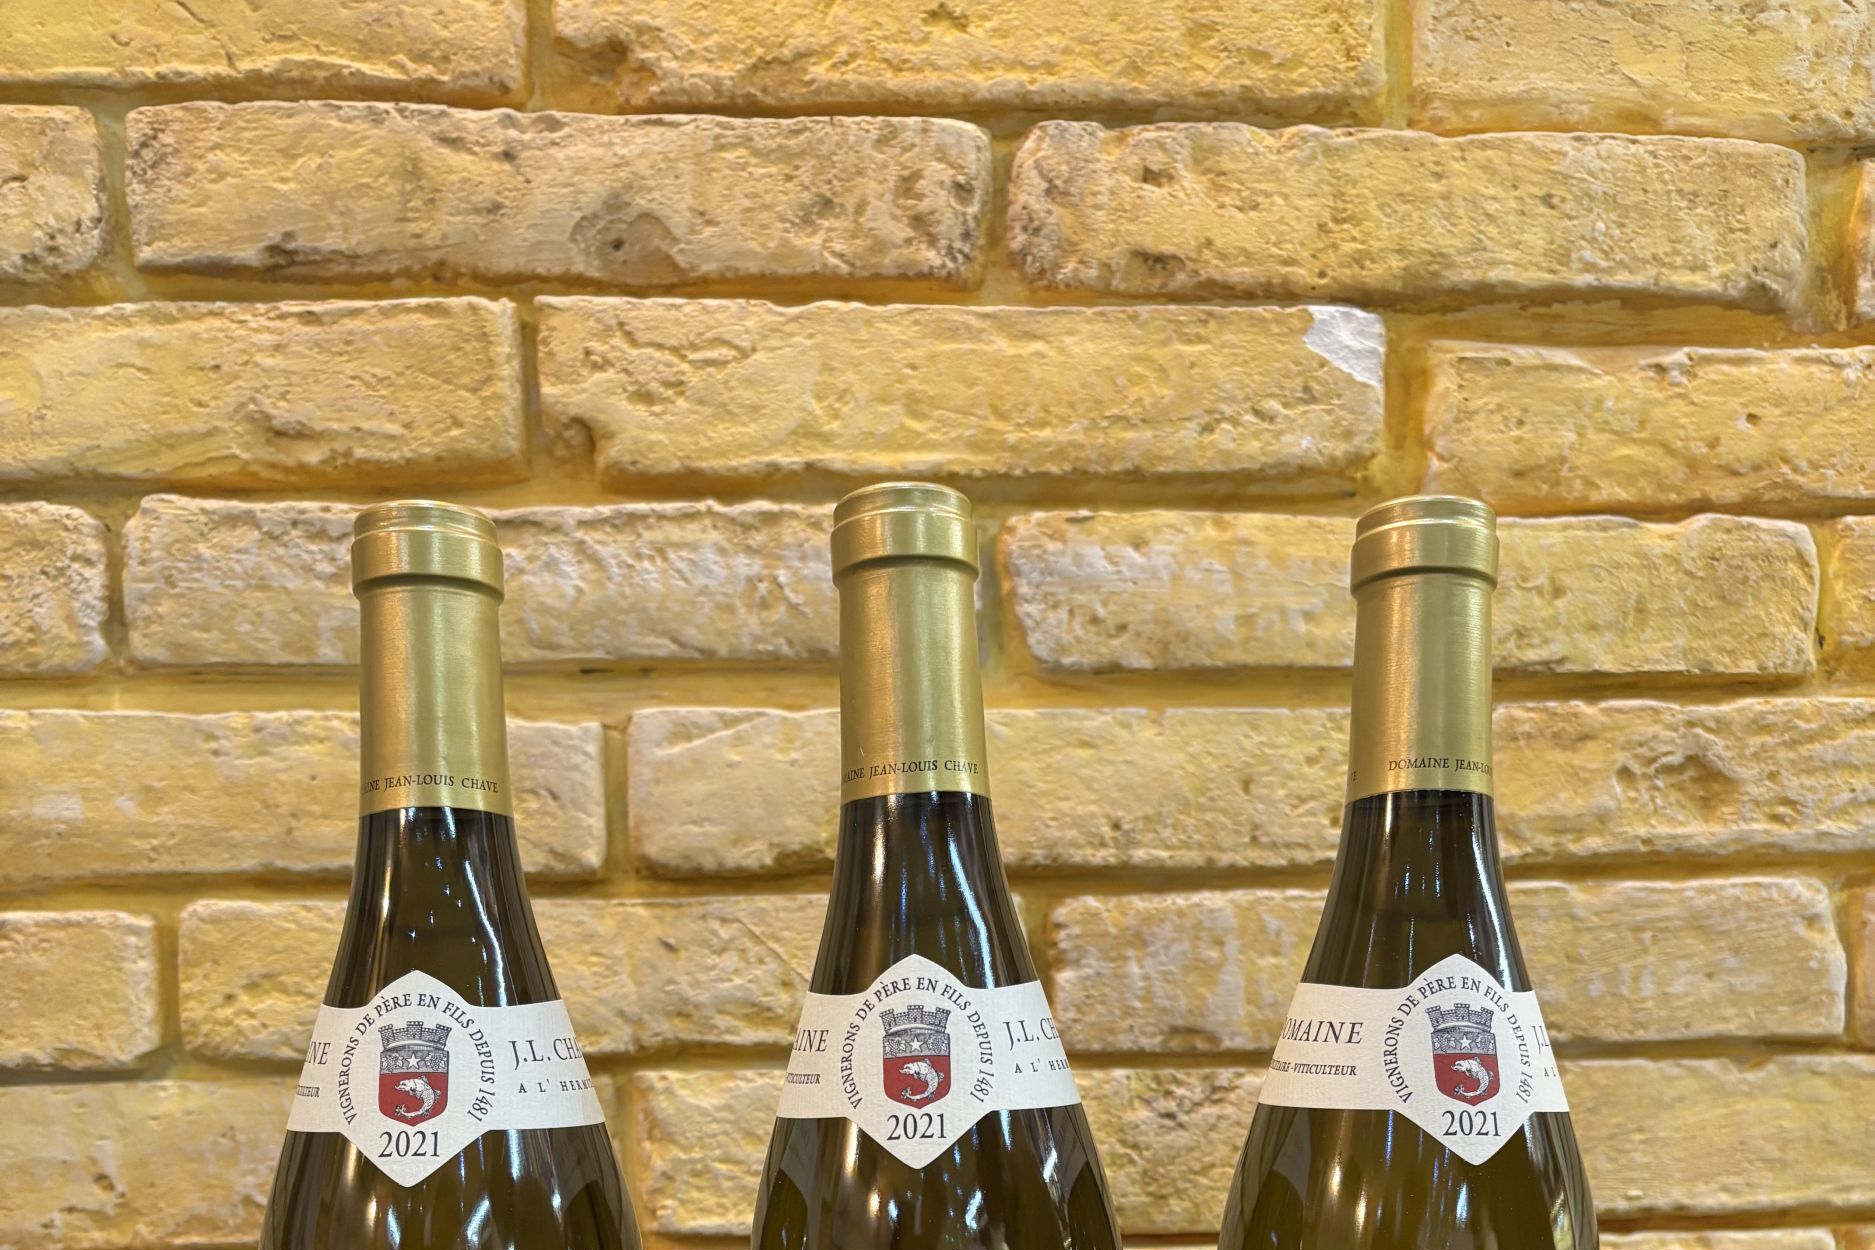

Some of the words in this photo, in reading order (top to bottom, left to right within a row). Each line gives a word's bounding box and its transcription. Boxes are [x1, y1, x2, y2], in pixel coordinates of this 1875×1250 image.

[869, 759, 938, 780] JEAN-LOUIS
[944, 760, 979, 775] CHAVE
[1388, 757, 1450, 771] DOMAINE
[384, 774, 454, 792] JEAN-LOUIS
[461, 777, 499, 794] CHAVE
[873, 977, 912, 1002] PÈRE
[916, 977, 939, 994] EN
[940, 984, 972, 1011] FILS
[1417, 976, 1457, 1000] PÈRE
[1460, 976, 1482, 993] EN
[374, 993, 412, 1018] PÈRE
[417, 993, 441, 1010] EN
[855, 999, 875, 1021] DE
[1397, 994, 1420, 1017] DE
[1484, 985, 1509, 1013] FILS
[355, 1013, 376, 1036] DE
[442, 1001, 475, 1030] FILS
[967, 1011, 993, 1066] DEPUIS
[1507, 1013, 1531, 1067] DEPUIS
[469, 1028, 495, 1084] DEPUIS
[841, 1022, 862, 1110] VIGNERONS
[1014, 1062, 1023, 1073] A
[1384, 1016, 1414, 1104] VIGNERONS
[338, 1036, 360, 1125] VIGNERONS
[518, 1082, 528, 1094] A
[969, 1070, 995, 1103] 1481
[1516, 1071, 1534, 1104] 1481
[467, 1088, 495, 1122] 1481
[886, 1112, 947, 1141] 2021
[1441, 1110, 1502, 1137] 2021
[378, 1130, 441, 1158] 2021
